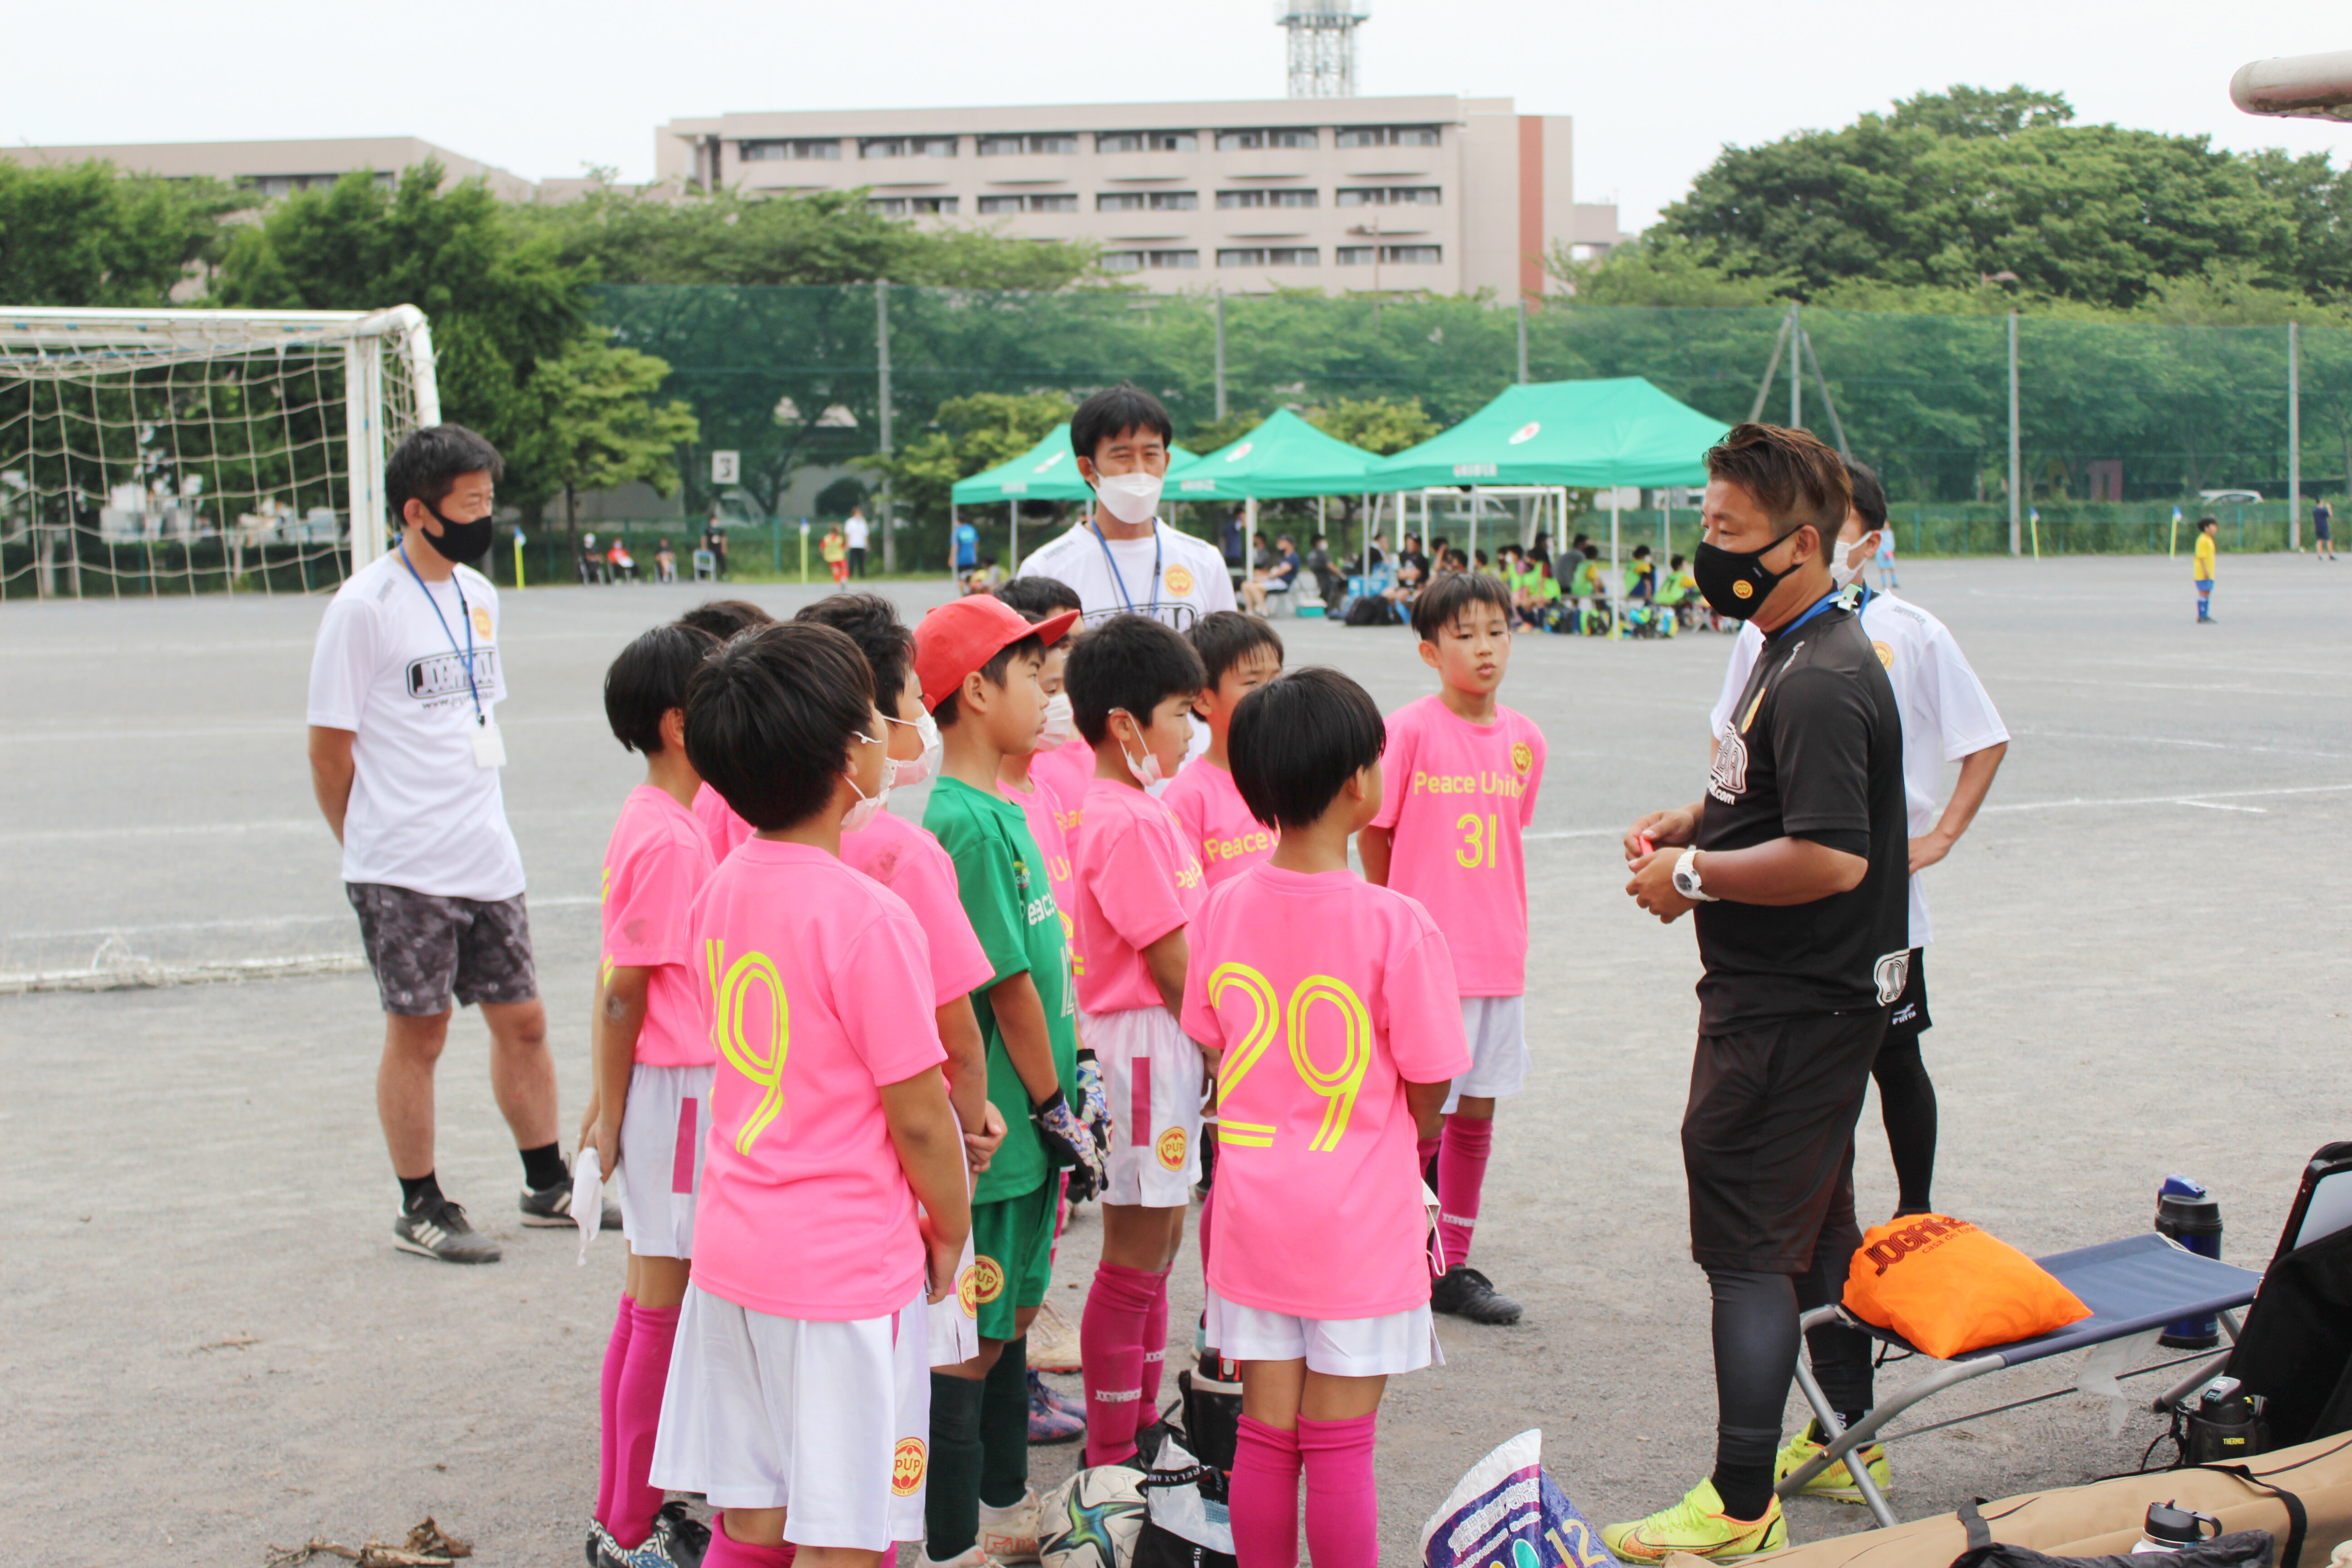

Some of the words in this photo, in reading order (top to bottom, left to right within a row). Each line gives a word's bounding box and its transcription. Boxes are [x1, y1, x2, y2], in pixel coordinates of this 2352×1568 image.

[720, 458, 731, 478] 3
[1415, 772, 1476, 795] Peace
[1481, 771, 1527, 799] Unity
[1204, 832, 1269, 862] Peace
[1456, 813, 1497, 868] 31
[1208, 962, 1371, 1152] 29
[1922, 1239, 1945, 1254] casa
[1945, 1231, 1959, 1240] de
[894, 1458, 920, 1472] PUP
[1165, 1467, 1200, 1482] RELAX
[1544, 1519, 1608, 1568] 12
